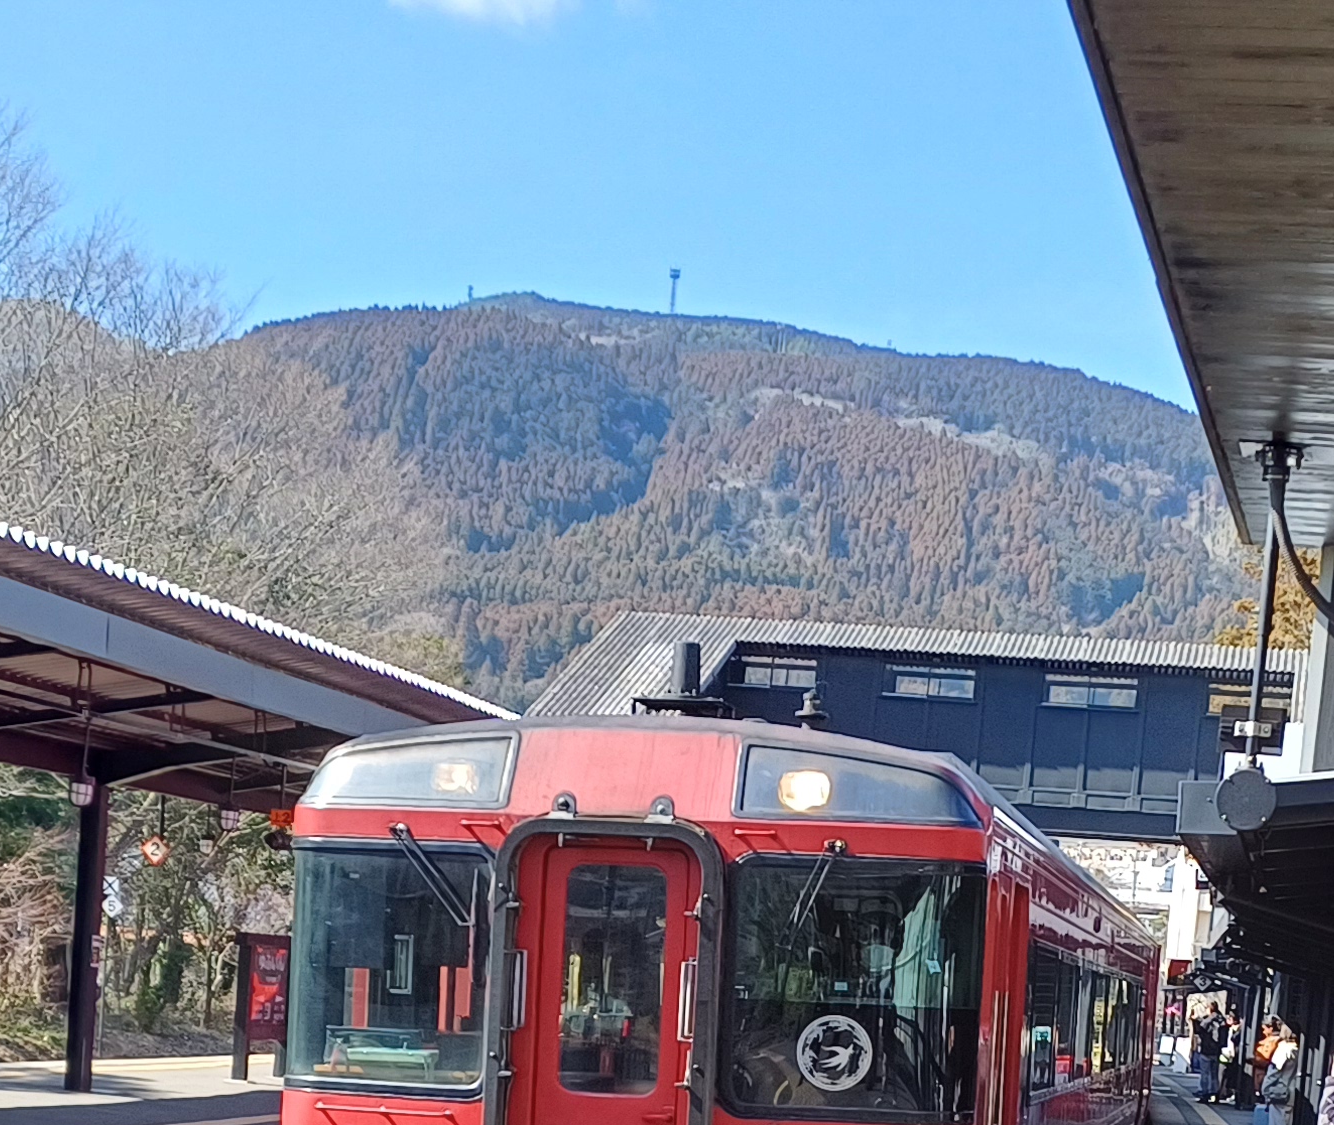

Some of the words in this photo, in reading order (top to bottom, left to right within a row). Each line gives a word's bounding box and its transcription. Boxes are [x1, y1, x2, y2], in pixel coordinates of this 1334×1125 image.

[150, 841, 160, 857] 2
[107, 900, 116, 912] 5
[1198, 976, 1207, 987] 3
